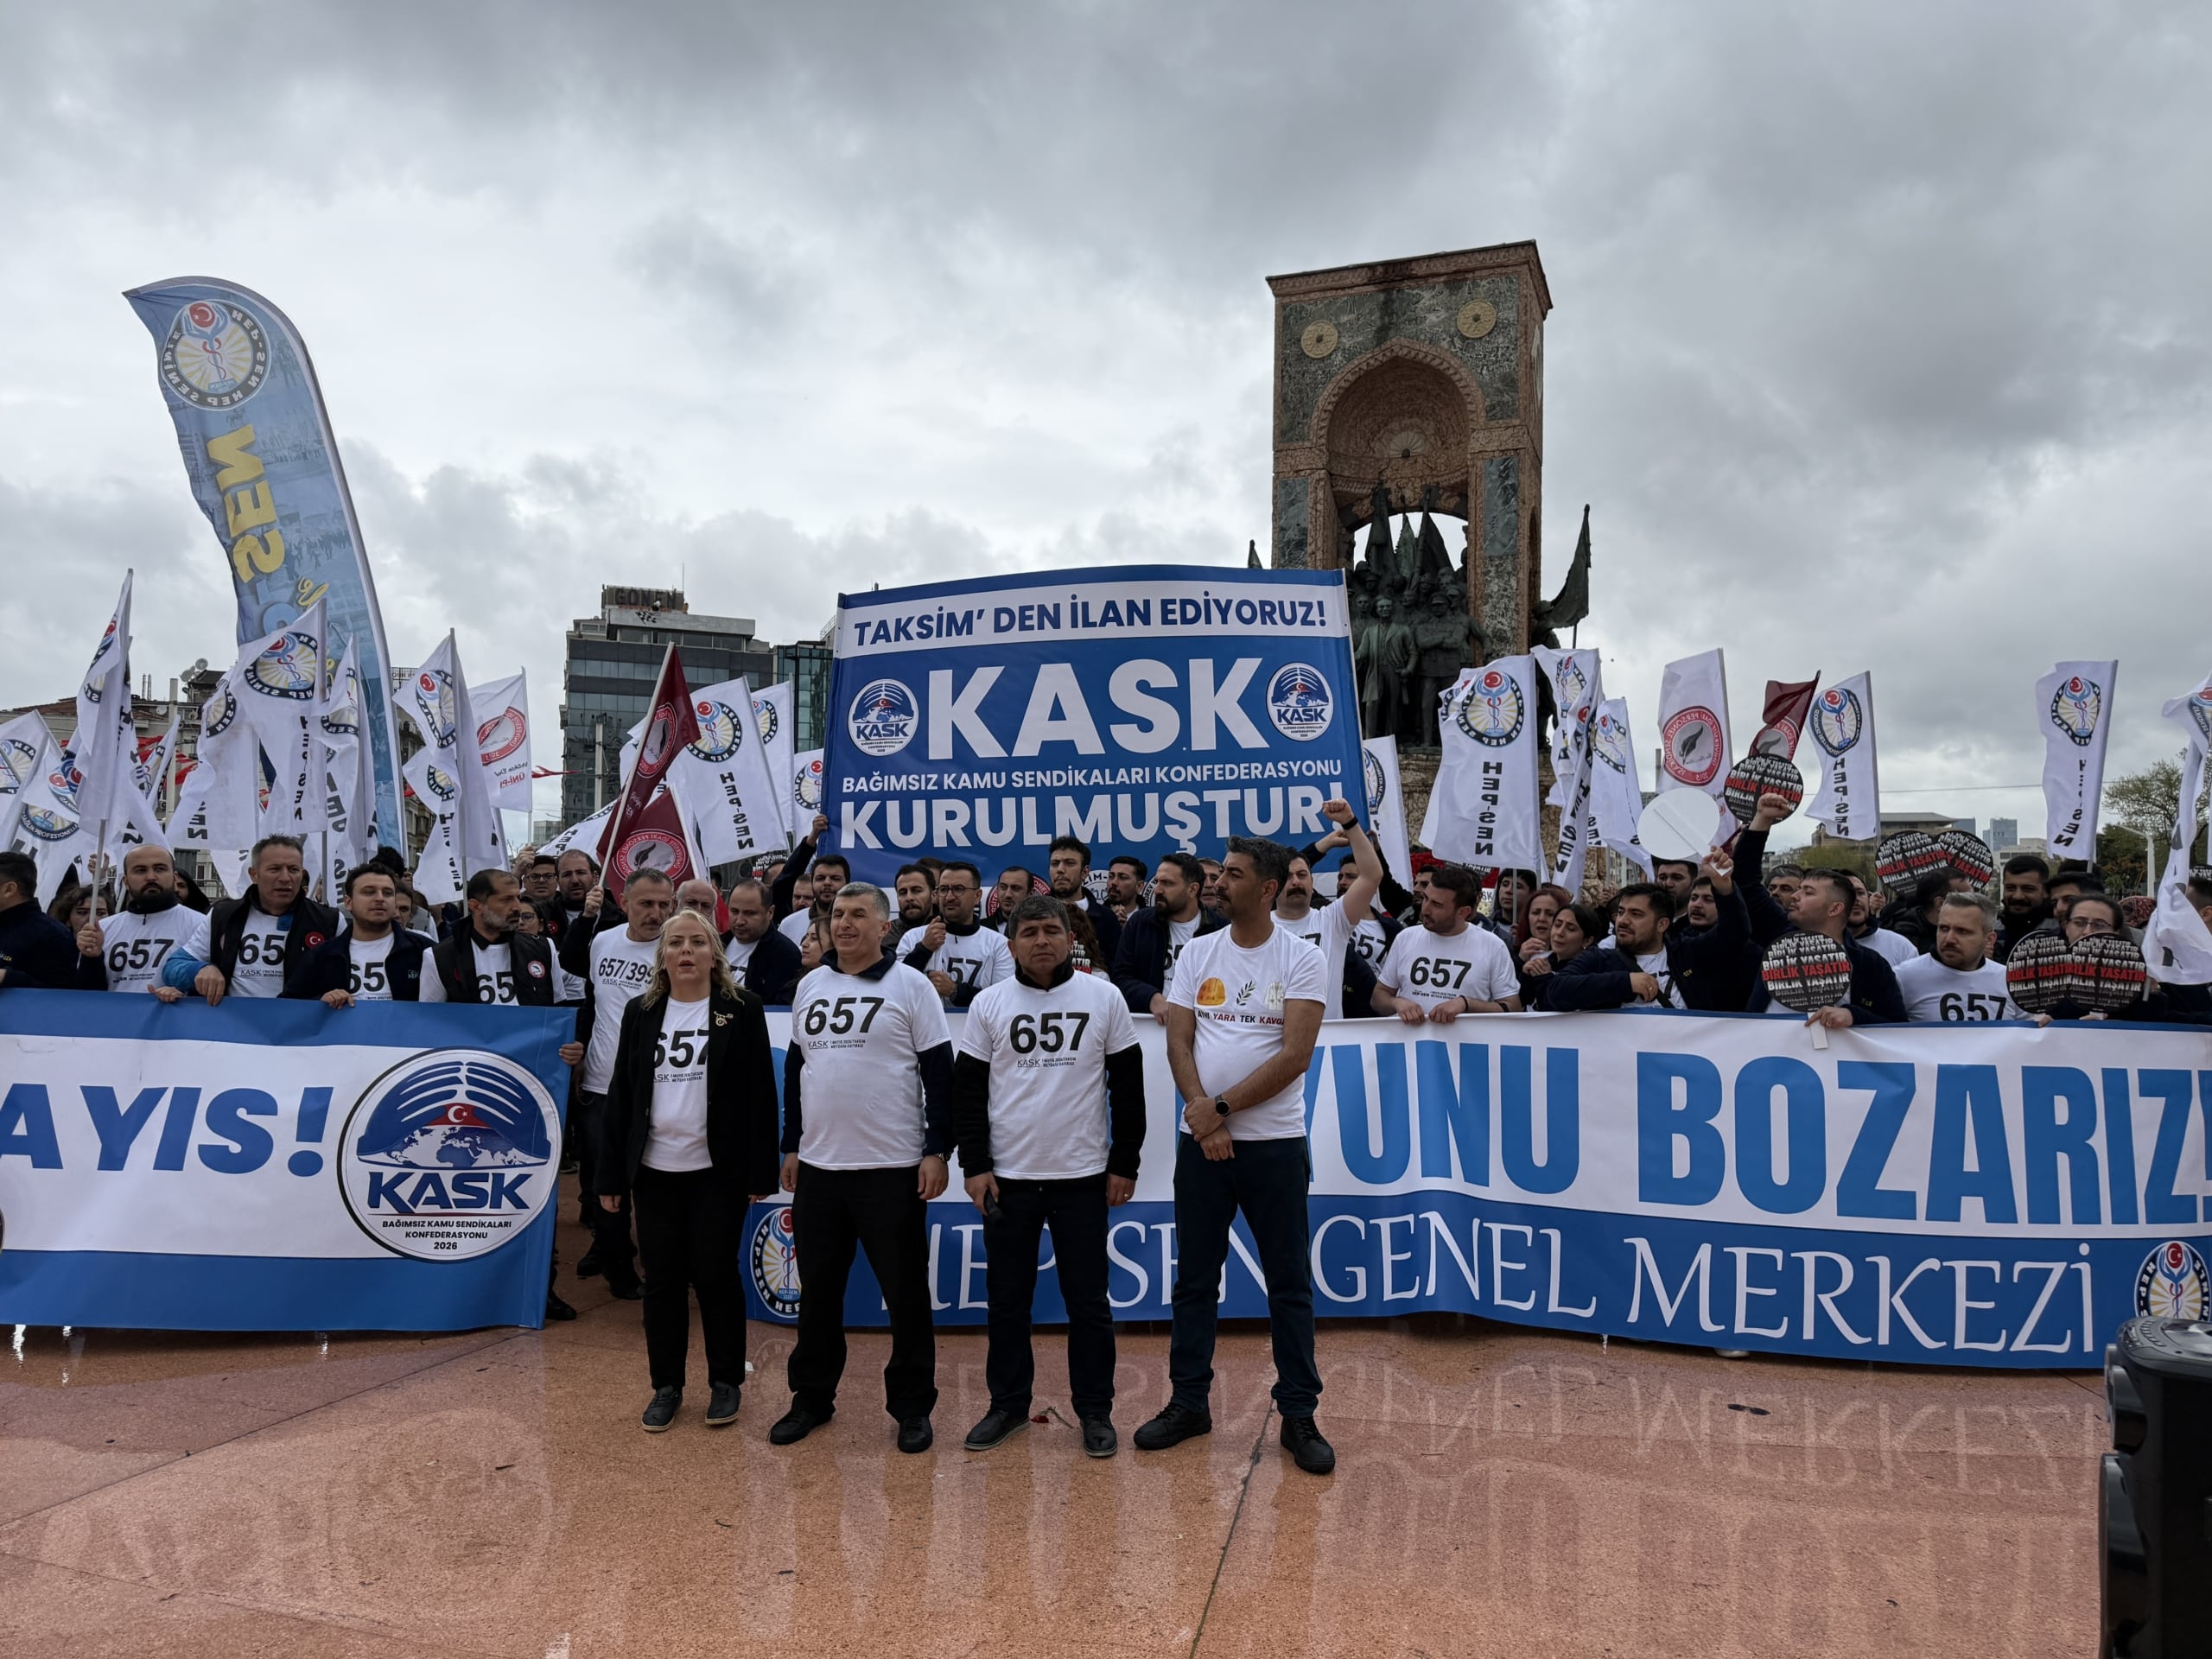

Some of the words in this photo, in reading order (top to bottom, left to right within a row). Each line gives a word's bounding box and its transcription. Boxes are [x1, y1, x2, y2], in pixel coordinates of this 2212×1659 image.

[994, 603, 1060, 633] DEN
[1071, 594, 1154, 628] İLAN
[1161, 590, 1326, 626] EDİYORUZ!
[928, 658, 1270, 760] KASK
[1276, 708, 1327, 725] KASK
[856, 722, 909, 741] KASK
[842, 770, 939, 794] BAĞIMSIZ
[944, 772, 1007, 791] KAMU
[1011, 766, 1151, 789] SENDİKALARI
[1155, 760, 1342, 785] KONFEDERASYONU
[841, 782, 1344, 855] KURULMUŞTUR!
[1877, 861, 1908, 876] BİRLİK
[1908, 850, 1947, 867] YAŞATIR
[108, 938, 175, 973] 657
[238, 934, 285, 966] 65
[1763, 955, 1797, 970] BİRLİK
[1800, 951, 1847, 964] YAŞATIR
[348, 962, 385, 995] 65
[947, 957, 983, 987] 57
[1409, 957, 1472, 990] 657
[1762, 964, 1800, 982] BİRLİK
[1802, 960, 1851, 976] YAŞATIR
[2007, 968, 2035, 982] BİRLİK
[2037, 963, 2074, 977] YAŞATIR
[2101, 967, 2146, 982] YAŞATIR
[477, 971, 518, 1004] 65
[804, 996, 885, 1035] 657
[1213, 1013, 1236, 1022] YARA
[1240, 1014, 1255, 1023] TEK
[1940, 993, 2007, 1022] 657
[654, 1029, 709, 1068] 657
[808, 1039, 829, 1049] KASK
[1009, 1012, 1090, 1054] 657
[1017, 1058, 1040, 1067] KASK
[368, 1171, 533, 1214] KASK
[382, 1218, 427, 1229] BAĞIMSIZ
[428, 1220, 454, 1229] KAMU
[456, 1219, 512, 1229] SENDİKALARI
[404, 1230, 488, 1239] KONFEDERASYONU
[433, 1241, 458, 1249] 2026
[754, 1224, 771, 1300] HEP-SEN
[1311, 1211, 1597, 1318] GENEL
[1623, 1237, 2093, 1353] MERKEZİ
